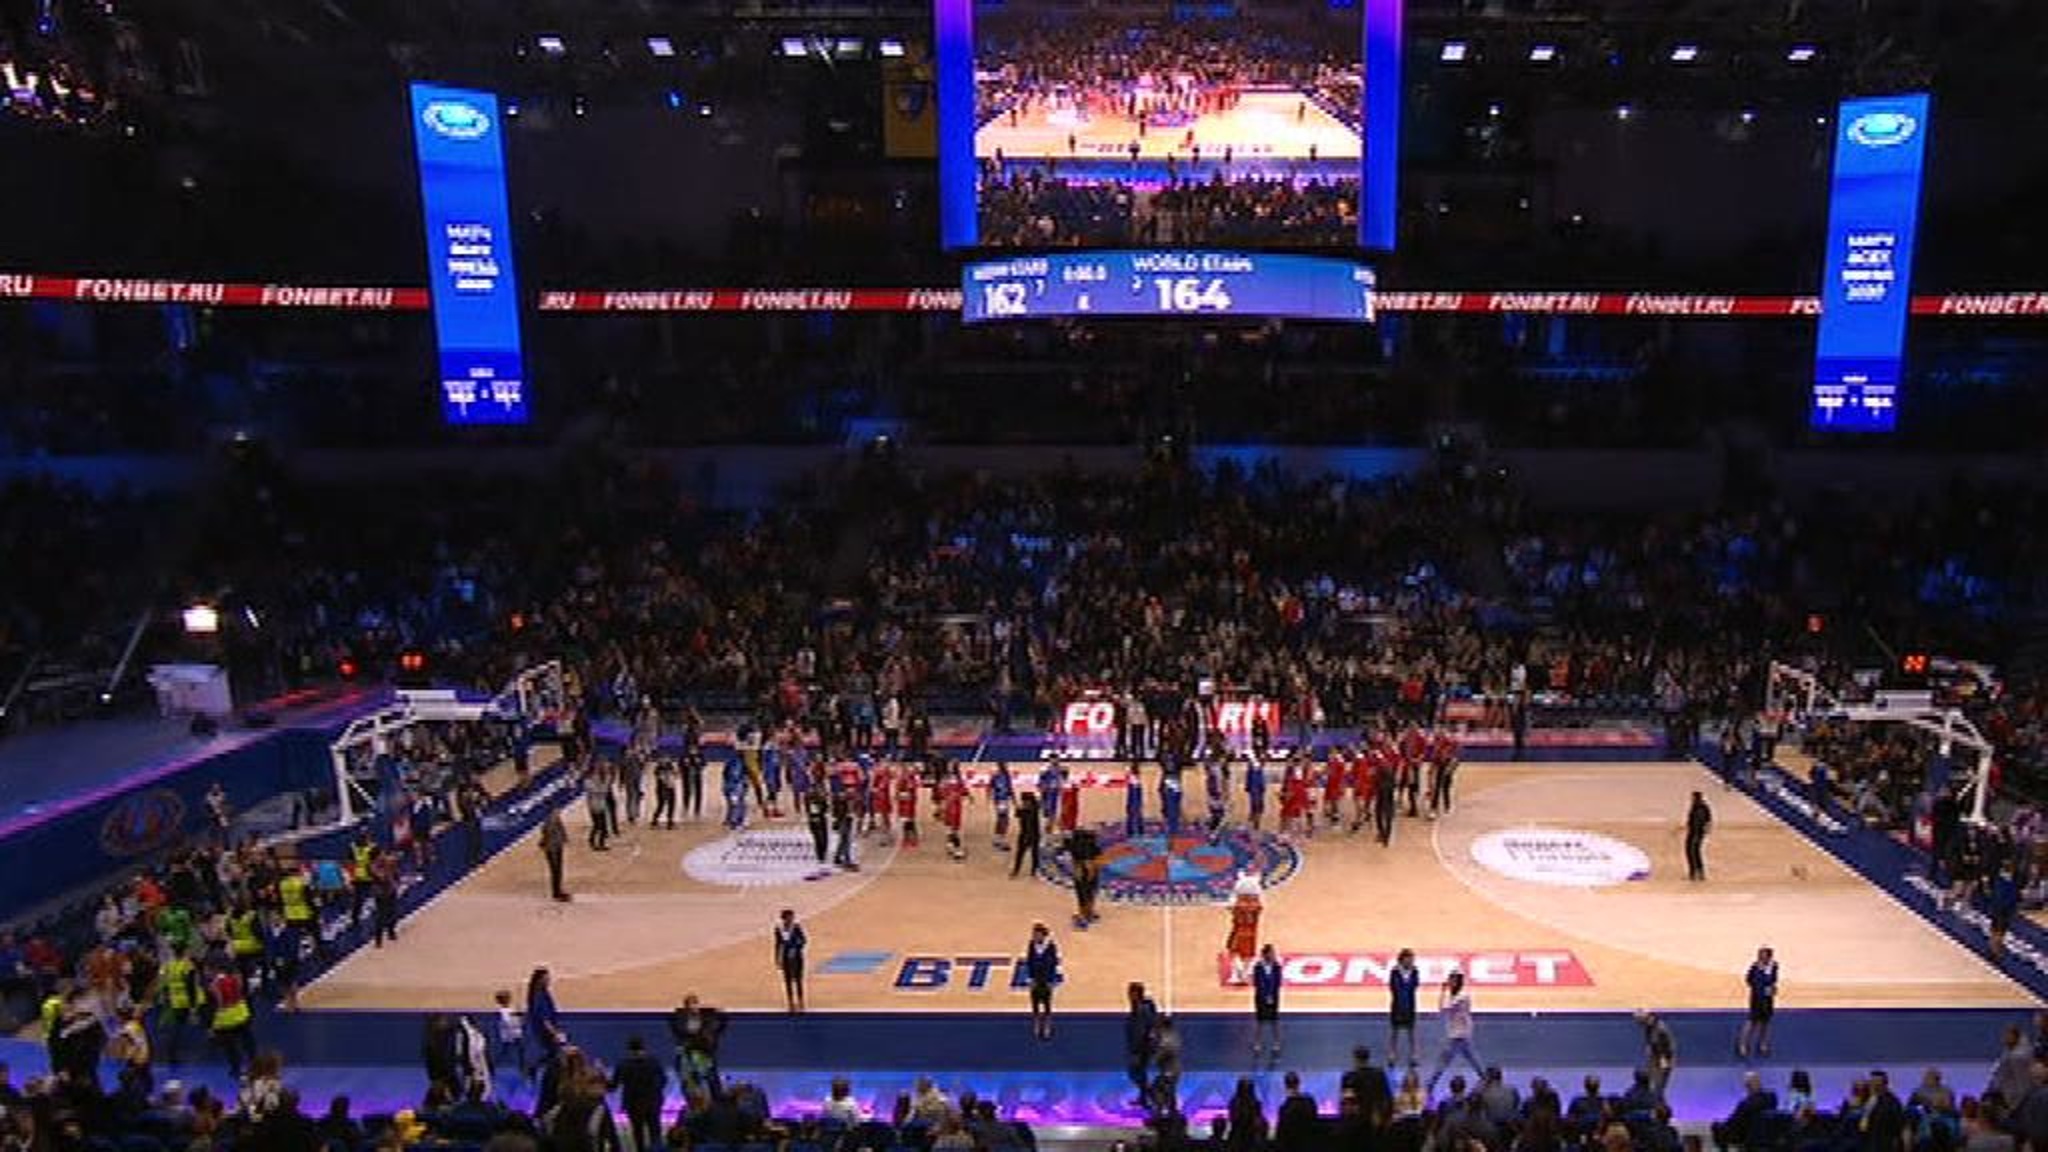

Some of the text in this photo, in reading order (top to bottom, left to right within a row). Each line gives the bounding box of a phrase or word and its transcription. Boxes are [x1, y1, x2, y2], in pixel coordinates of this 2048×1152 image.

[1132, 253, 1199, 272] WORLD
[75, 279, 224, 304] FONBET.RU
[261, 286, 393, 306] FONBET.RU
[604, 291, 714, 310] FONBET.RU
[740, 289, 853, 310] FONBET.RU
[984, 283, 1027, 316] 162
[1154, 278, 1232, 311] 164
[1489, 291, 1600, 311] FONBET.RU
[1626, 293, 1735, 314] FONBET.RU
